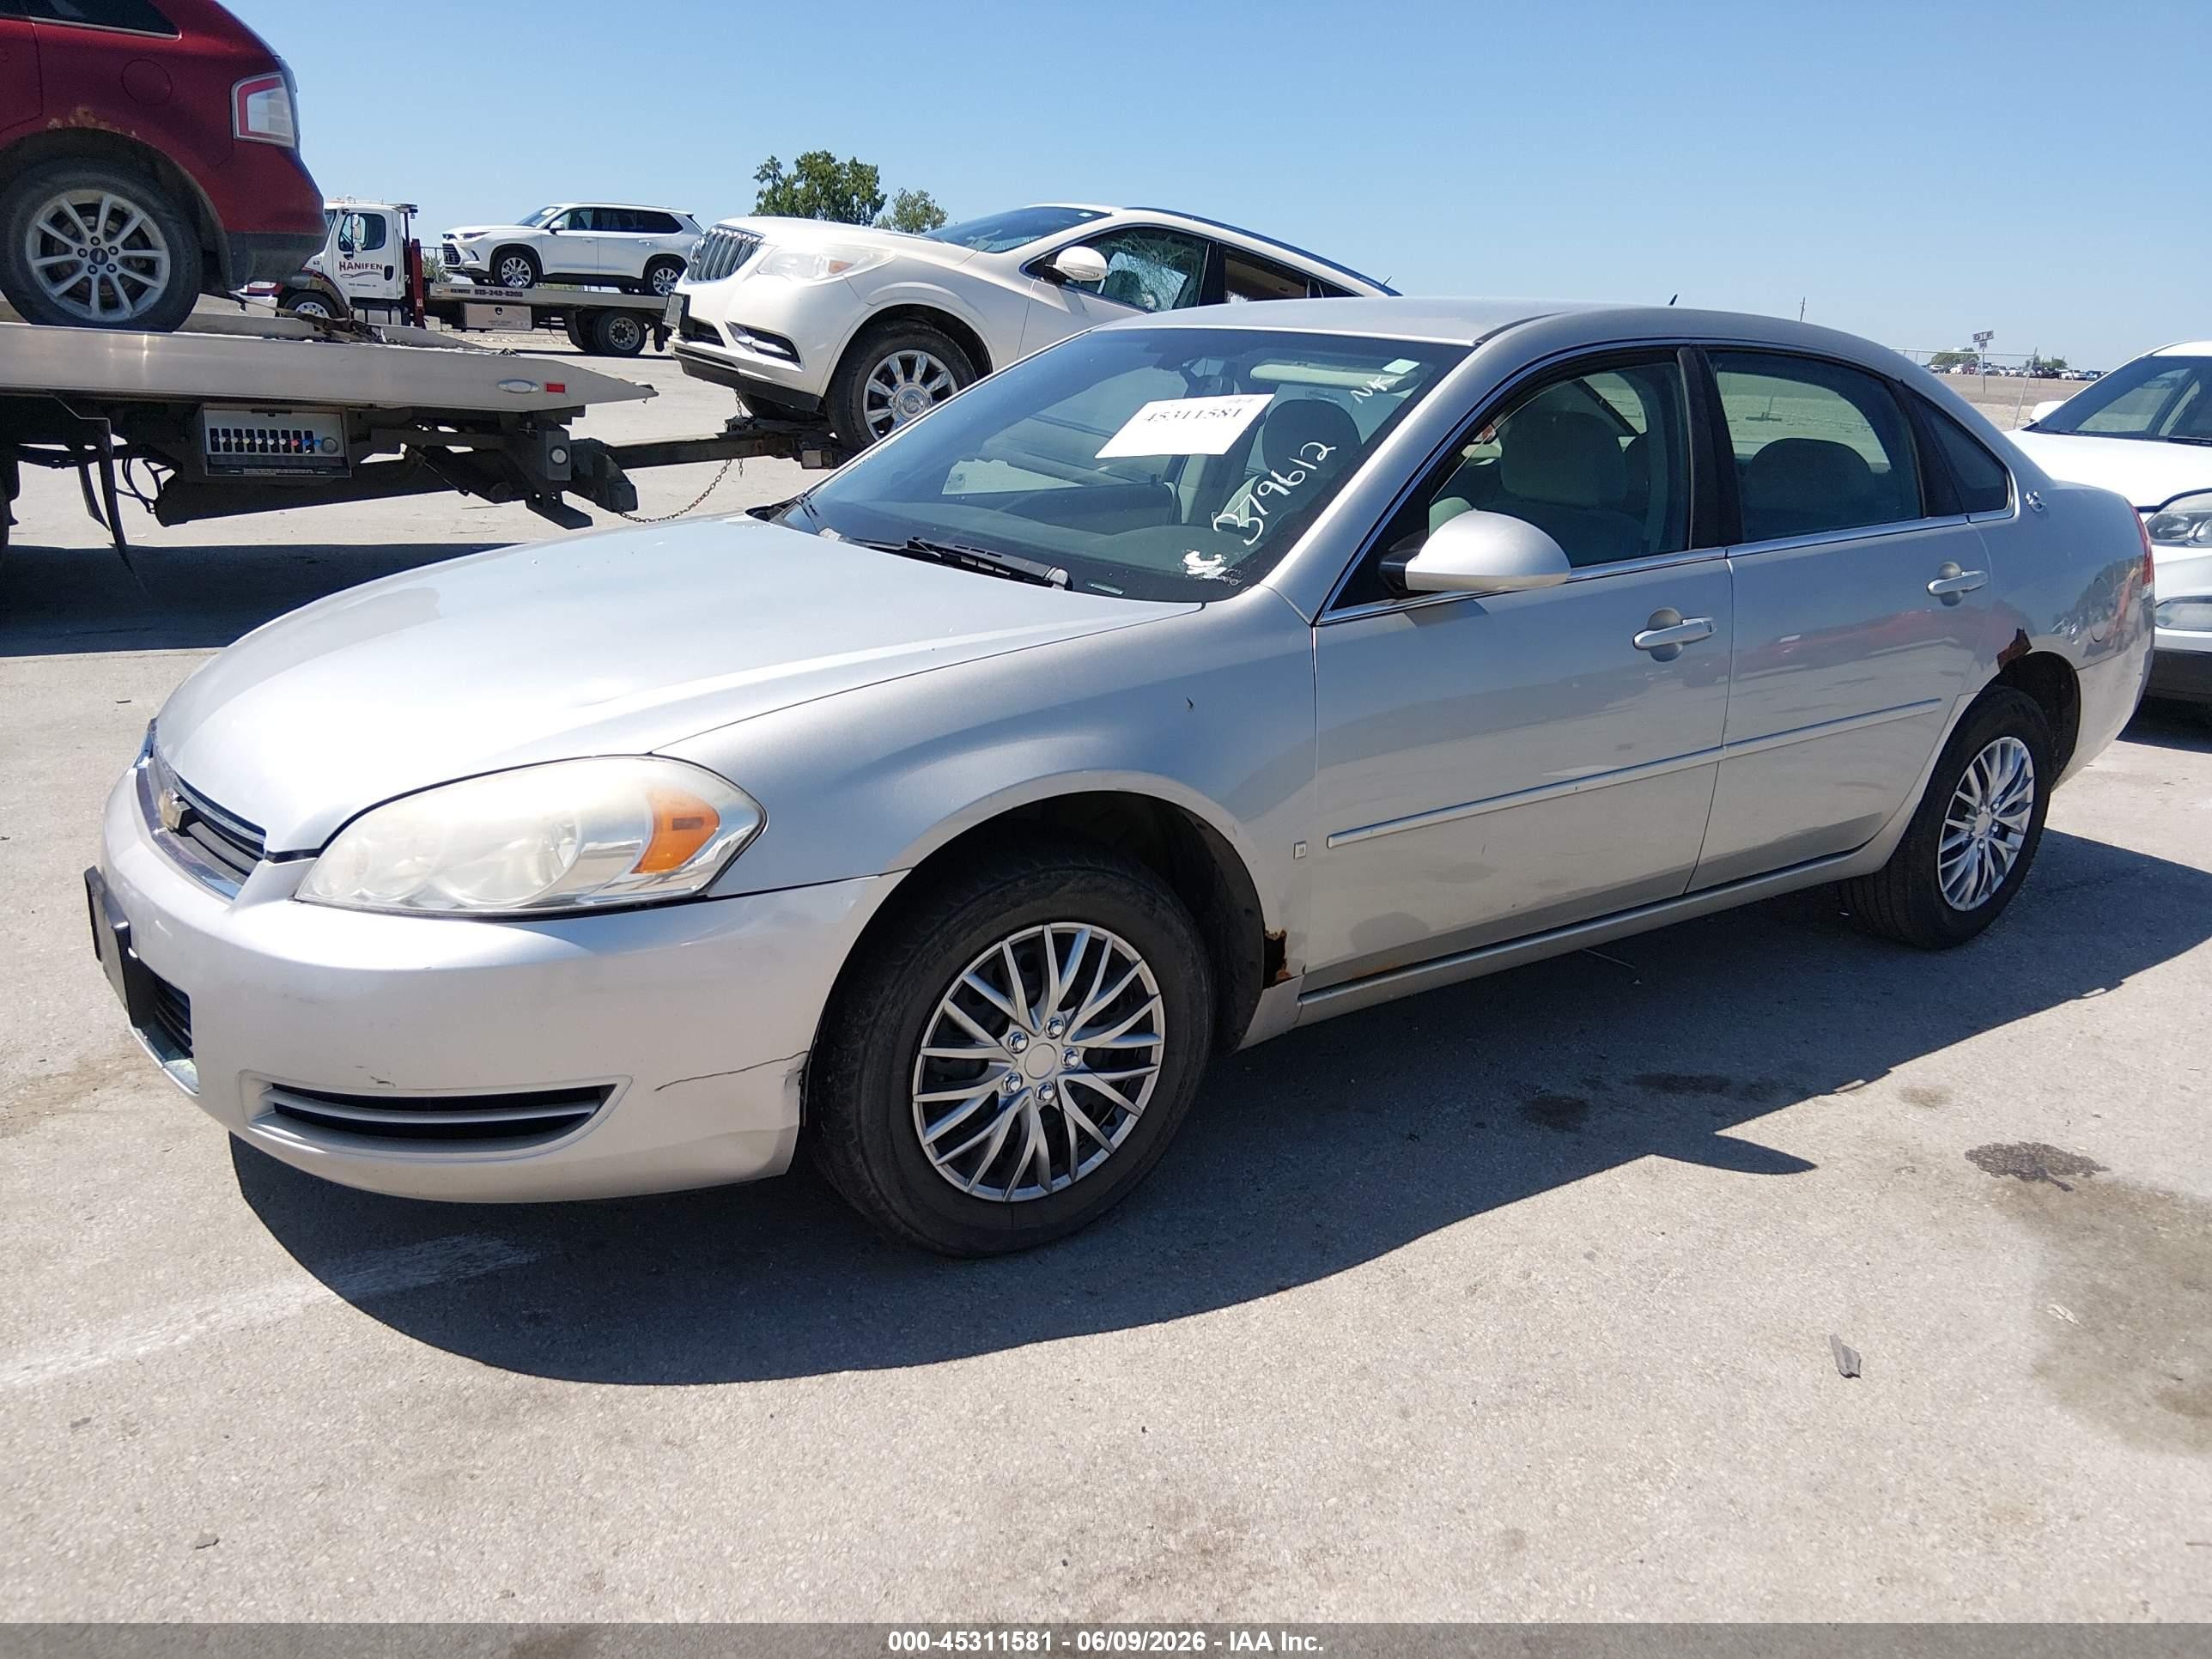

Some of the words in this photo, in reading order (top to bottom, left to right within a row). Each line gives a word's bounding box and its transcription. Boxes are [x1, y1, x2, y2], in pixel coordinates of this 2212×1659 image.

[338, 261, 384, 271] HANIFEN
[1143, 408, 1244, 422] 45311581
[1212, 441, 1338, 546] 379612
